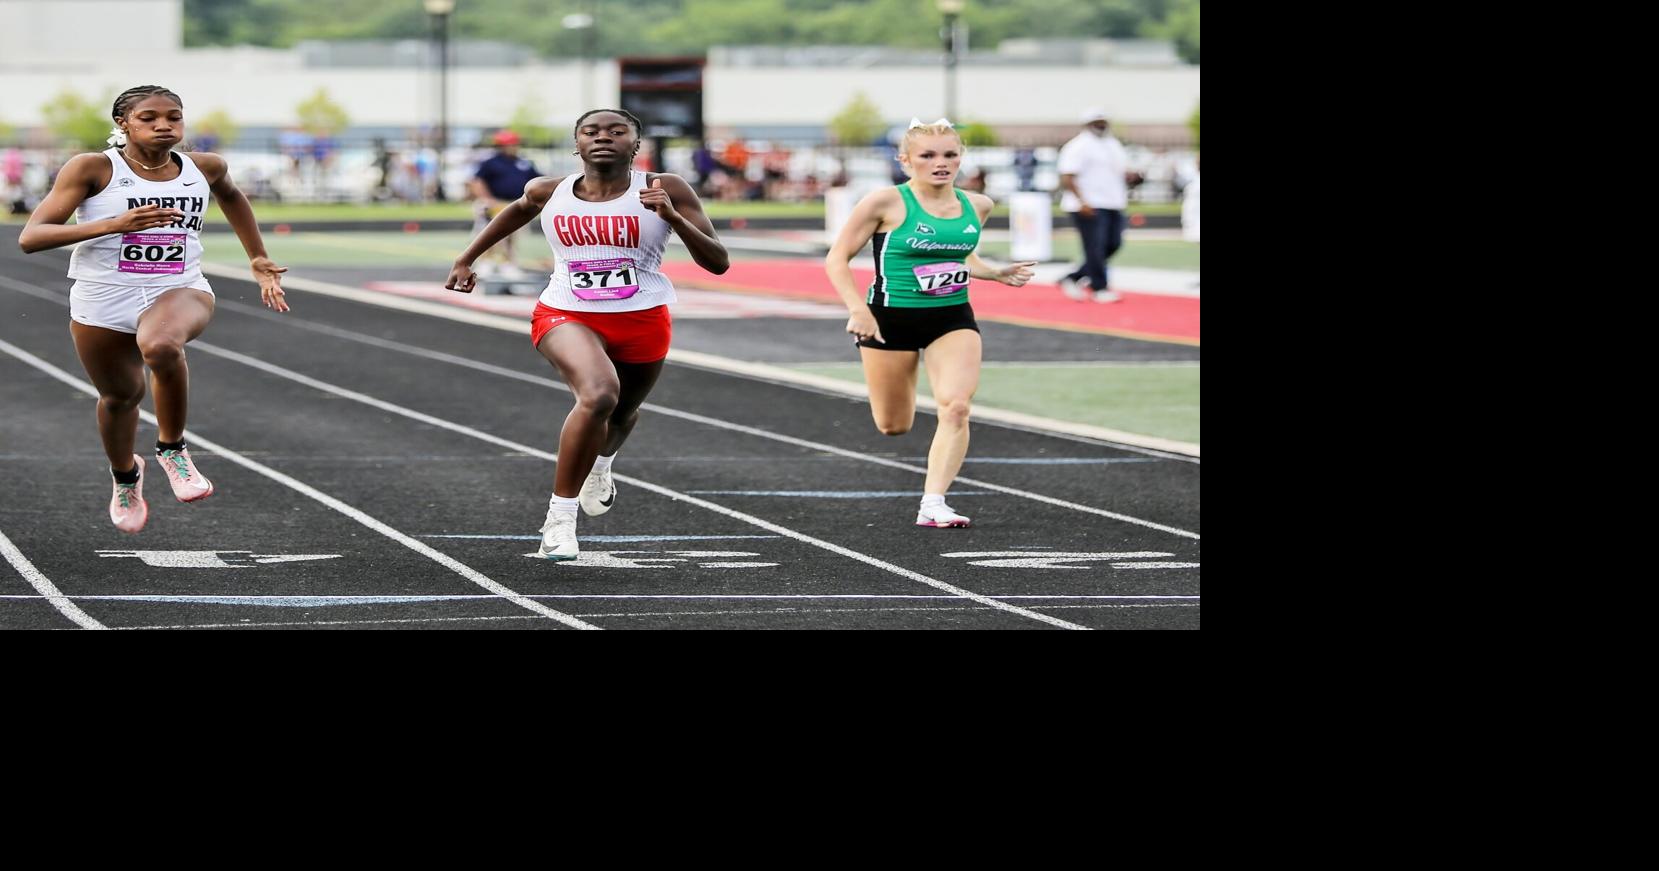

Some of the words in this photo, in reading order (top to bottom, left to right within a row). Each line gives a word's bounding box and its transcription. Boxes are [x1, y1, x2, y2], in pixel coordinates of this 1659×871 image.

[126, 196, 204, 213] NORTH
[553, 215, 640, 249] GOSHEN
[123, 245, 183, 261] 602
[906, 237, 975, 252] Valparaiso
[573, 269, 632, 289] 371
[920, 270, 968, 289] 720
